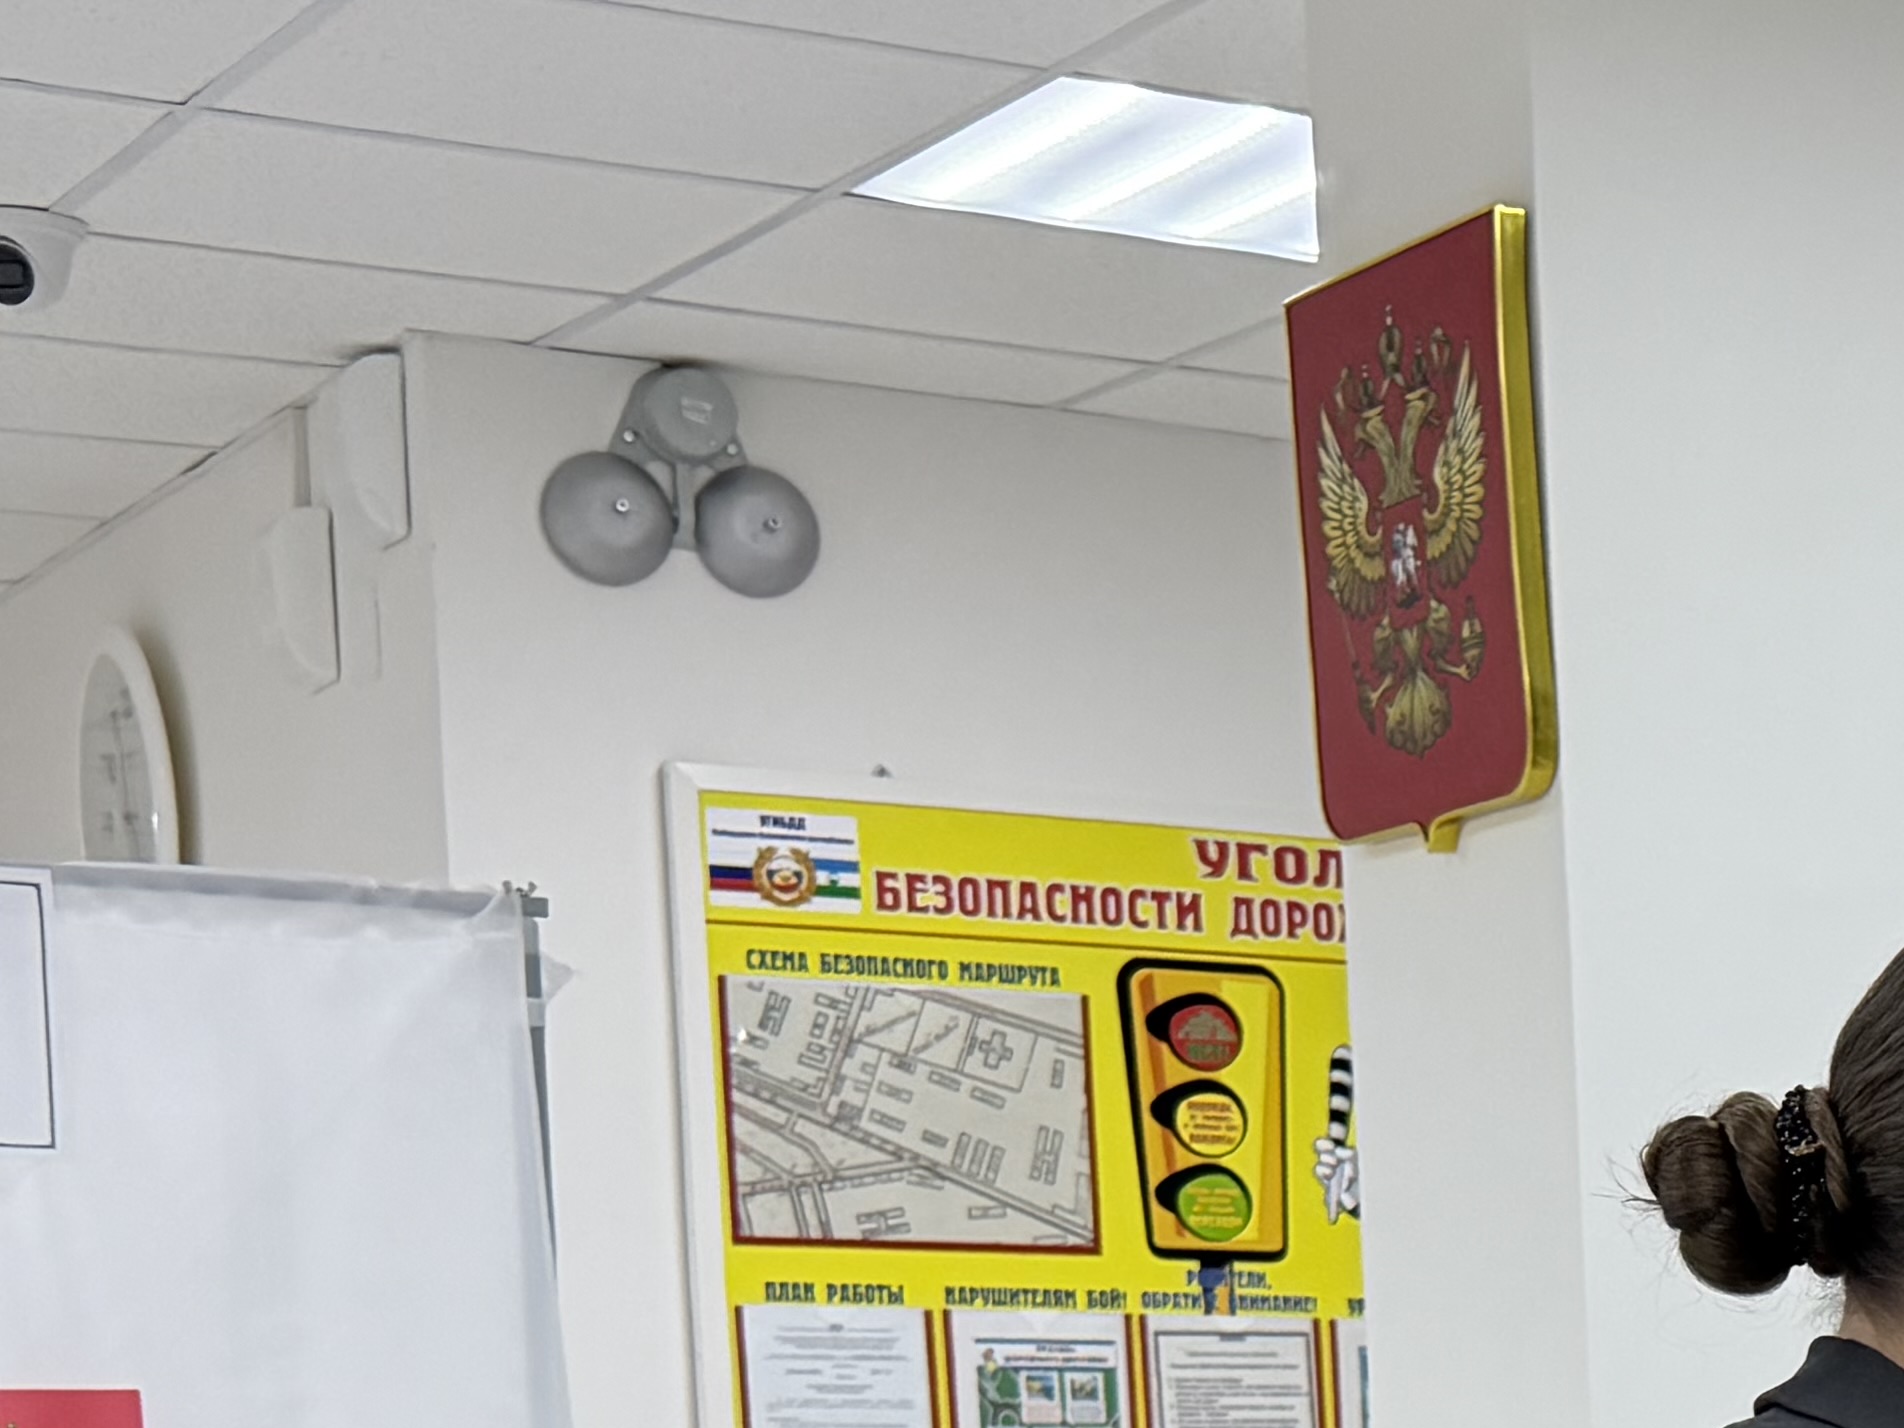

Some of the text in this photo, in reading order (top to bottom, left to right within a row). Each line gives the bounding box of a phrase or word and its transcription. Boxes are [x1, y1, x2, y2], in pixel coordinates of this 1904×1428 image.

[1192, 837, 1343, 888] УГОЛ
[874, 870, 1345, 942] БЕЗОПАСНОСТИ ДОРО
[746, 949, 1061, 987] СХЕМА БЕЗОПАСНОГО МАРШРУТА
[764, 1281, 904, 1305] ПЛАН РАБОТЫ
[945, 1286, 1078, 1309] НАРУШИТЕЛЯМ
[1141, 1292, 1206, 1311] ОБРАТИ
